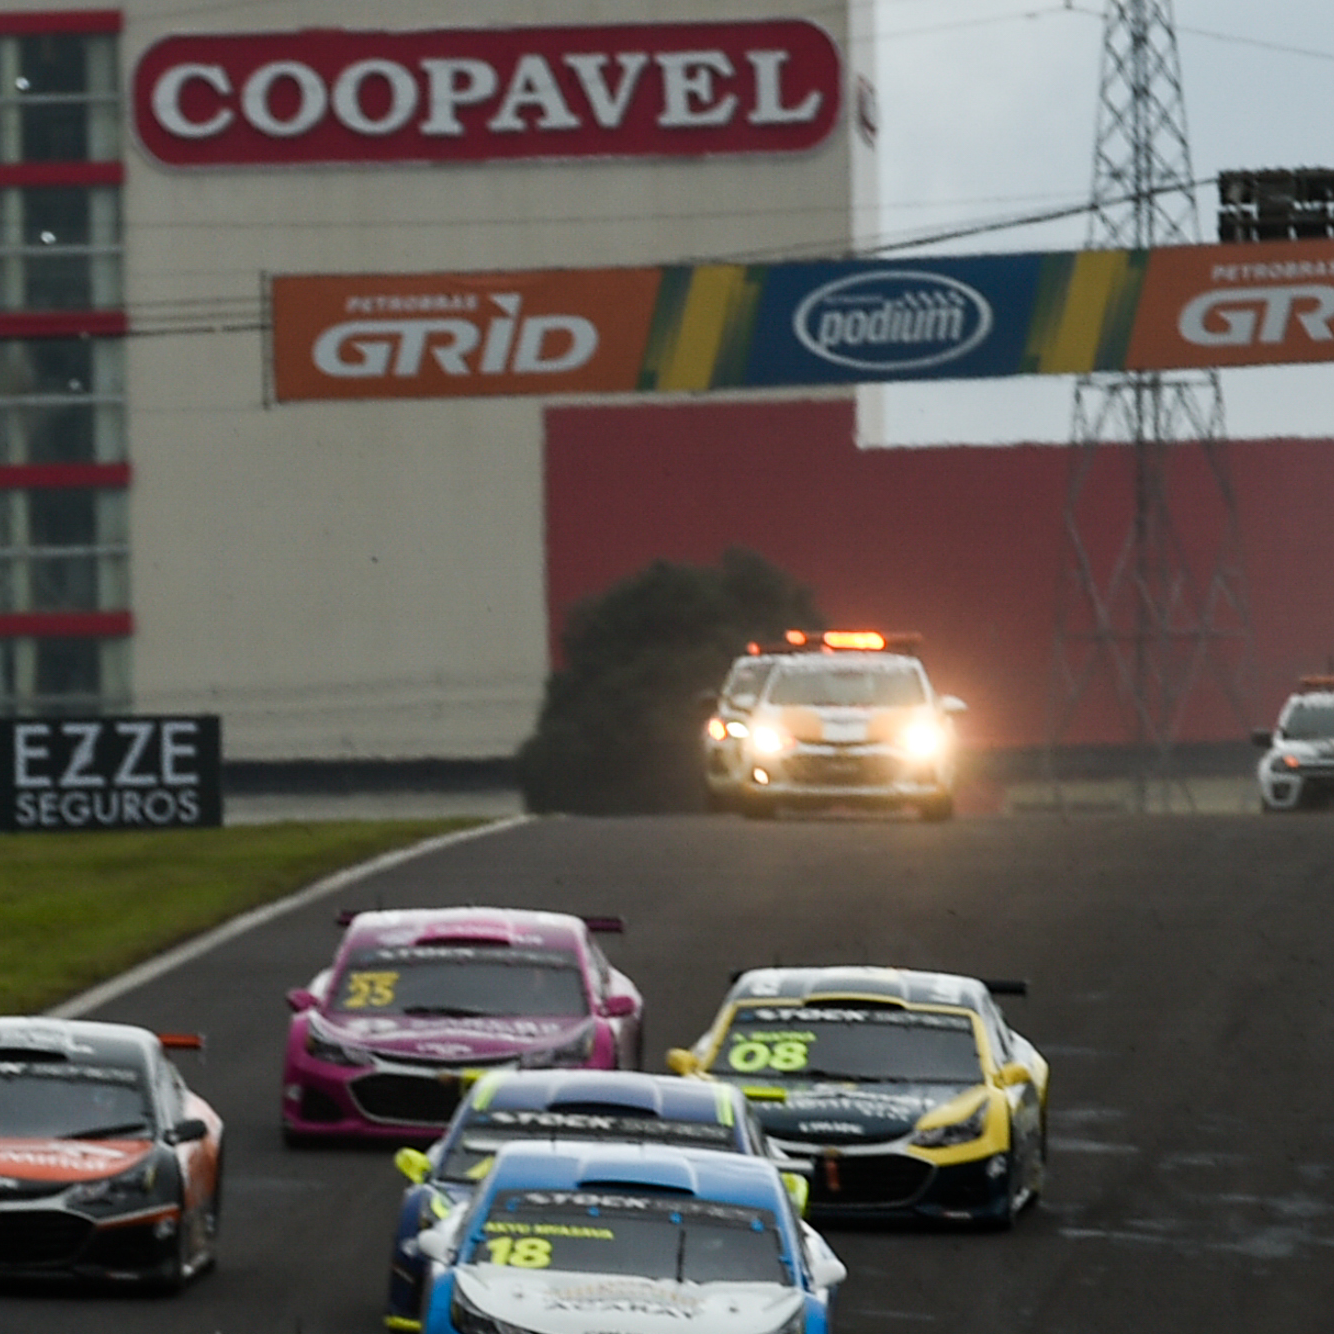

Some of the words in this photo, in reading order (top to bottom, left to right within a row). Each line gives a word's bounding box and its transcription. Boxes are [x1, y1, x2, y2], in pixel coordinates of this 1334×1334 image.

[151, 49, 823, 138] COOPAVEL
[819, 301, 964, 350] podium
[15, 722, 198, 786] EZZE
[16, 790, 198, 826] SEGUROS
[728, 1041, 809, 1072] 08
[486, 1236, 553, 1268] 18
